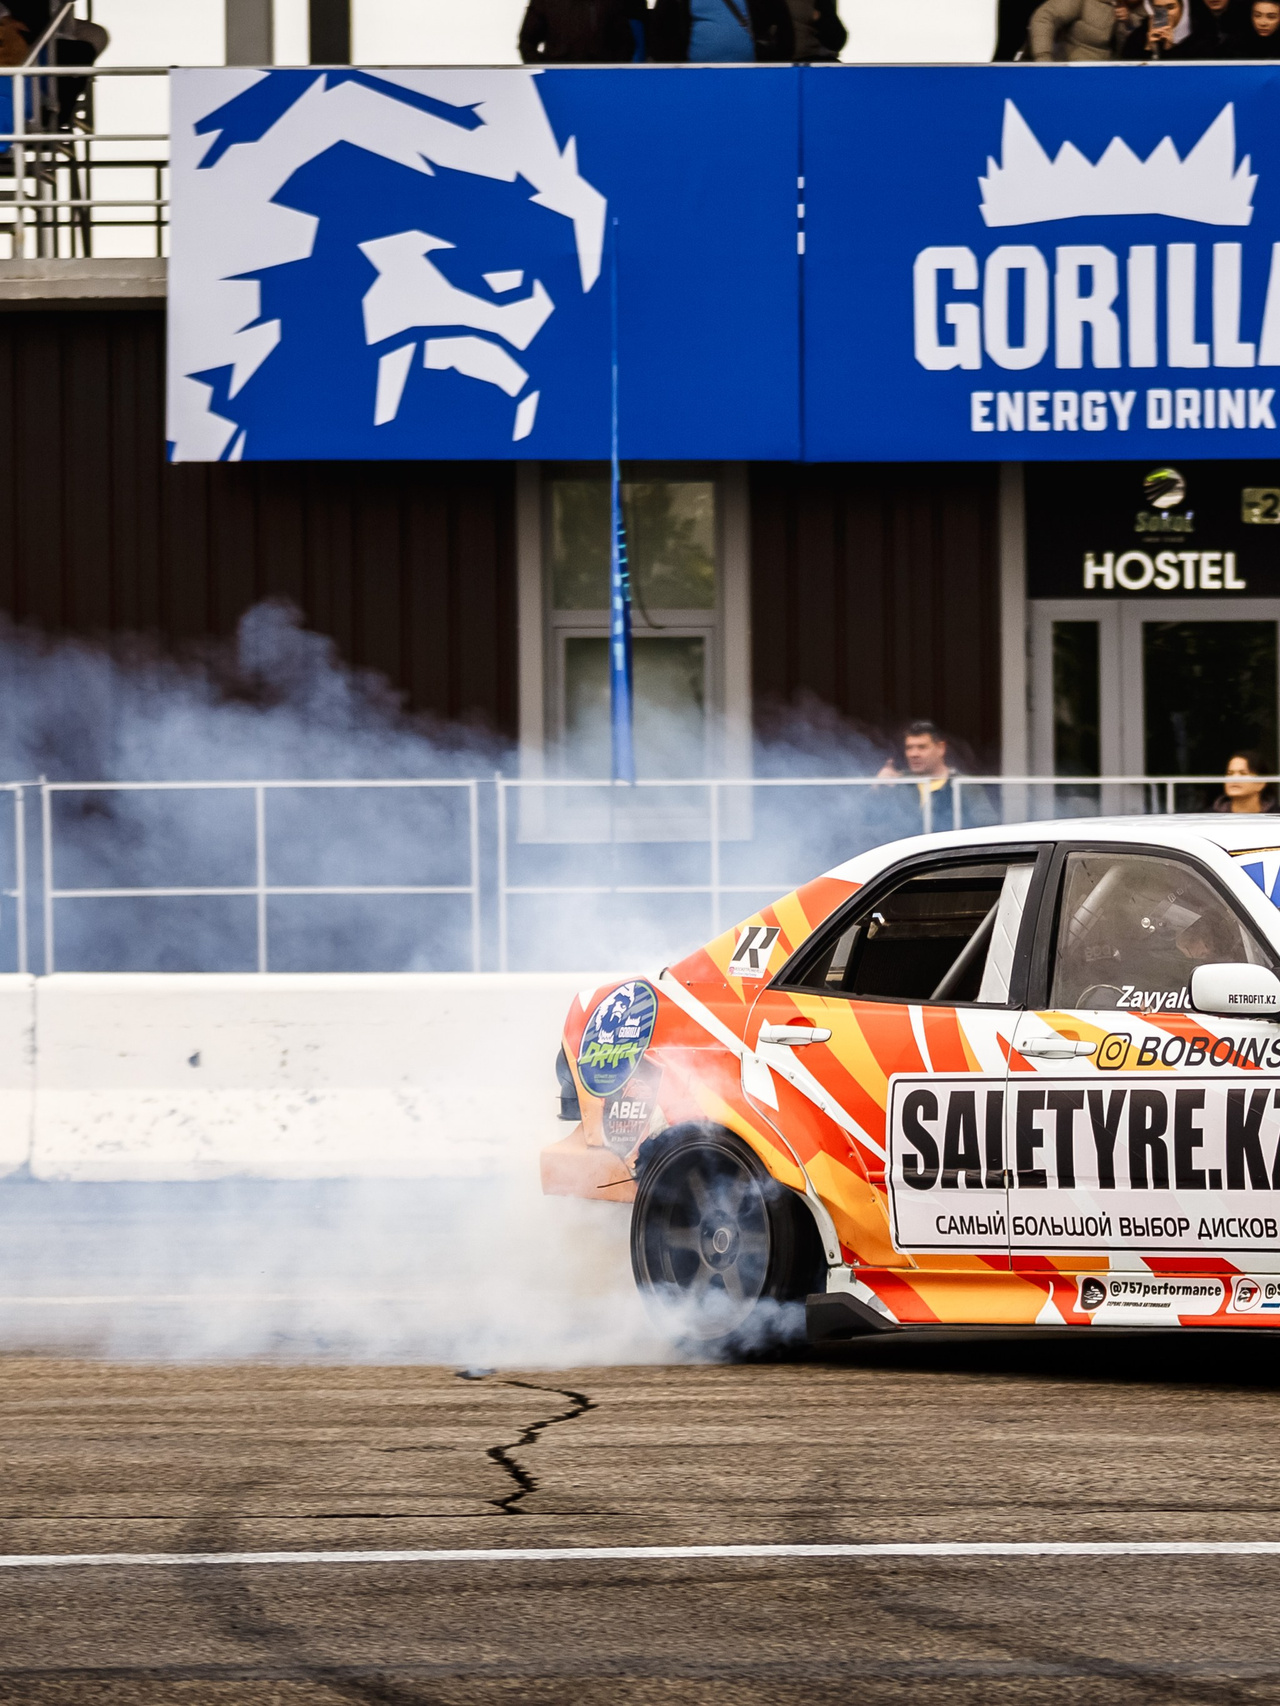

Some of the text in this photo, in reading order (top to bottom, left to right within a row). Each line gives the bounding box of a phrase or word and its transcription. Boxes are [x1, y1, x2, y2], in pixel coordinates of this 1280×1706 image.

[971, 388, 1277, 432] ENERGY DRINK
[1084, 551, 1246, 590] HOSTEL
[1228, 994, 1277, 1005] RETROFIT.KZ
[579, 1041, 642, 1069] DRIFT
[609, 1101, 648, 1119] ABEL
[935, 1210, 1279, 1240] САМЫЙ БОЛЬШОЙ ВЫБОР ДИСКОВ
[1110, 1280, 1222, 1297] @757performance
